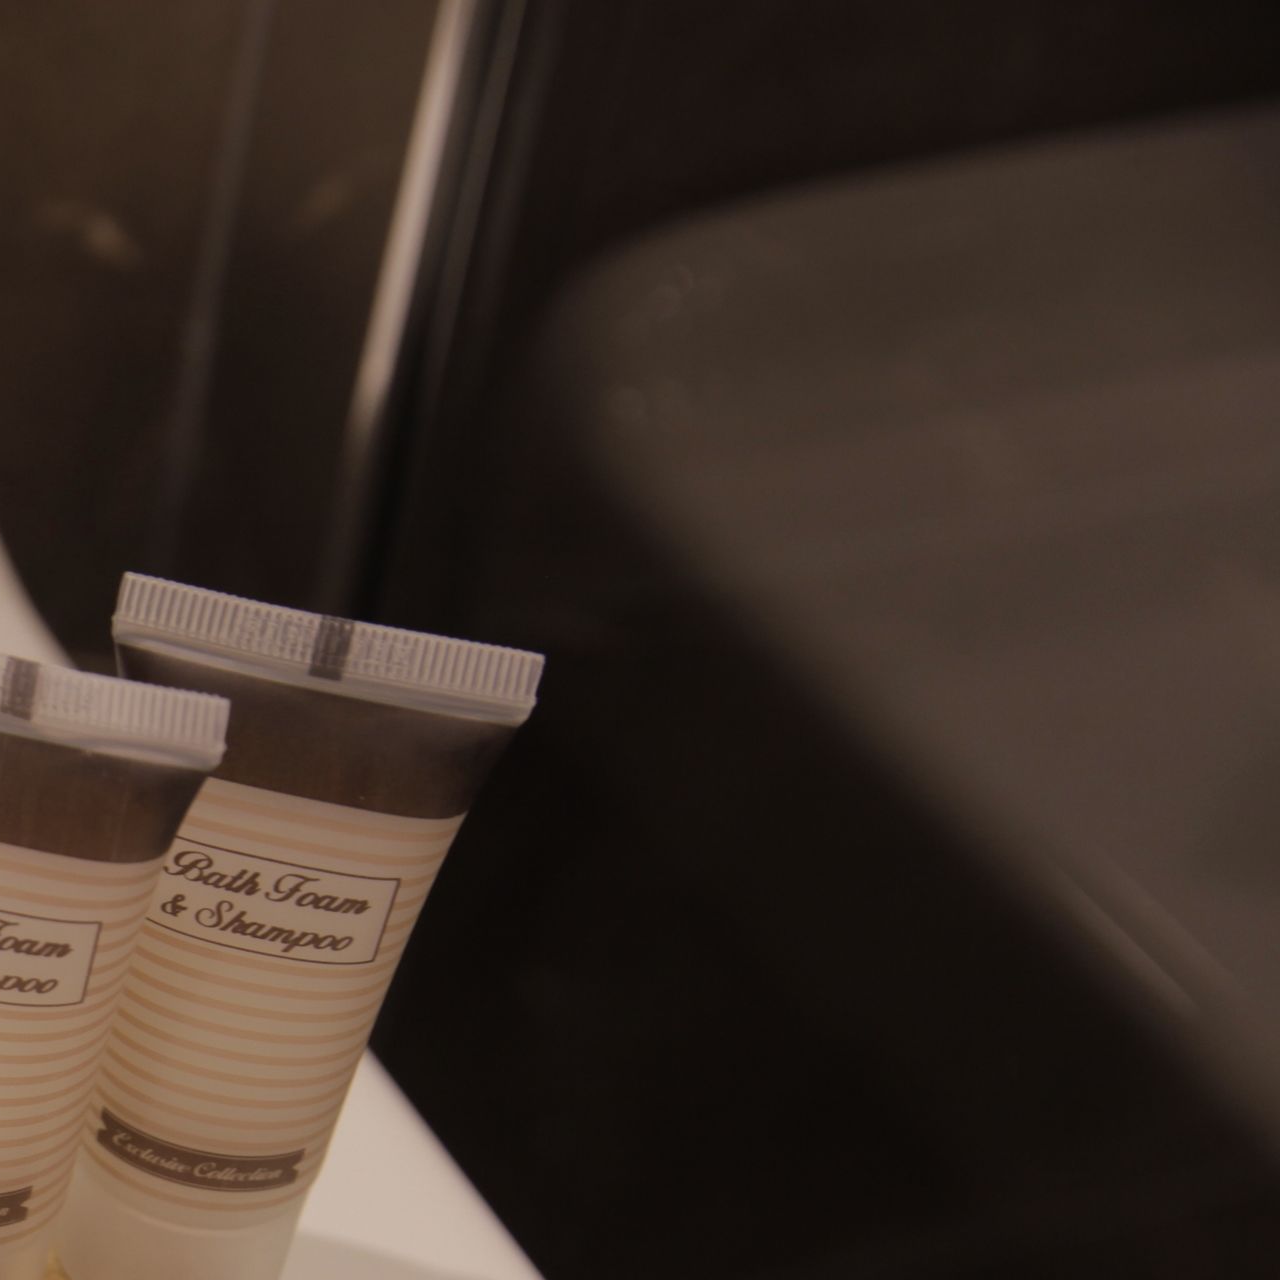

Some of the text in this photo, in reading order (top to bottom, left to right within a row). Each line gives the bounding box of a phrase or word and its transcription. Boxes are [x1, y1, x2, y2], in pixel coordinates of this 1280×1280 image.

[163, 850, 372, 915] Bath Foam
[161, 894, 354, 953] & Shampoo
[193, 1162, 284, 1181] Collection
